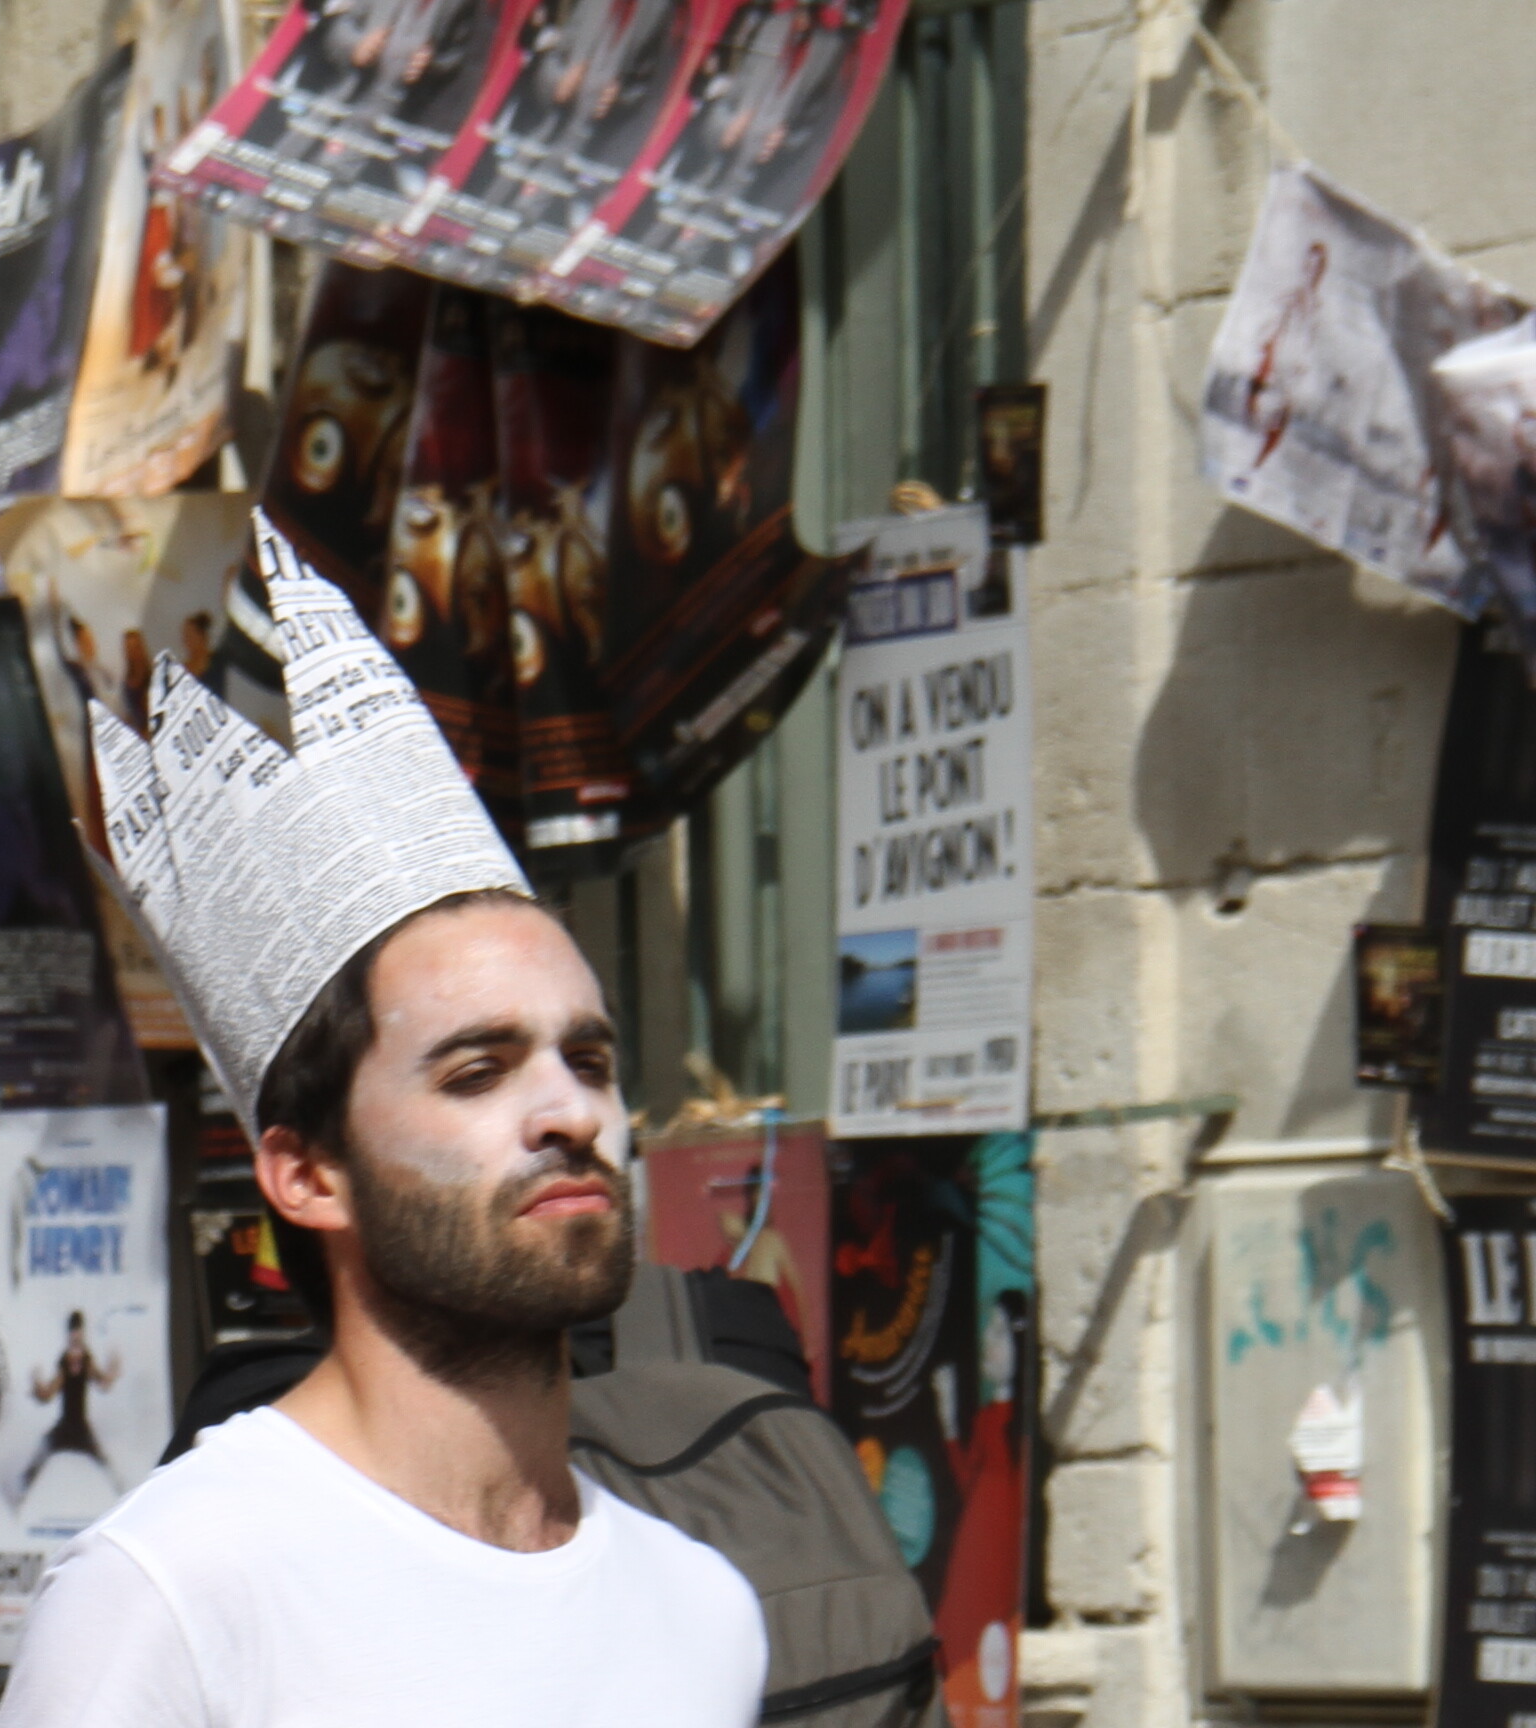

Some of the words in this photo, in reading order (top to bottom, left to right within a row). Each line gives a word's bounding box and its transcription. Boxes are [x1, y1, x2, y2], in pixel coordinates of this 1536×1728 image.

[850, 681, 892, 753] ON
[898, 677, 915, 741] A
[923, 651, 1016, 731] VENDU
[878, 753, 909, 824] LE
[914, 736, 987, 816] PONT
[1461, 1231, 1521, 1326] LE
